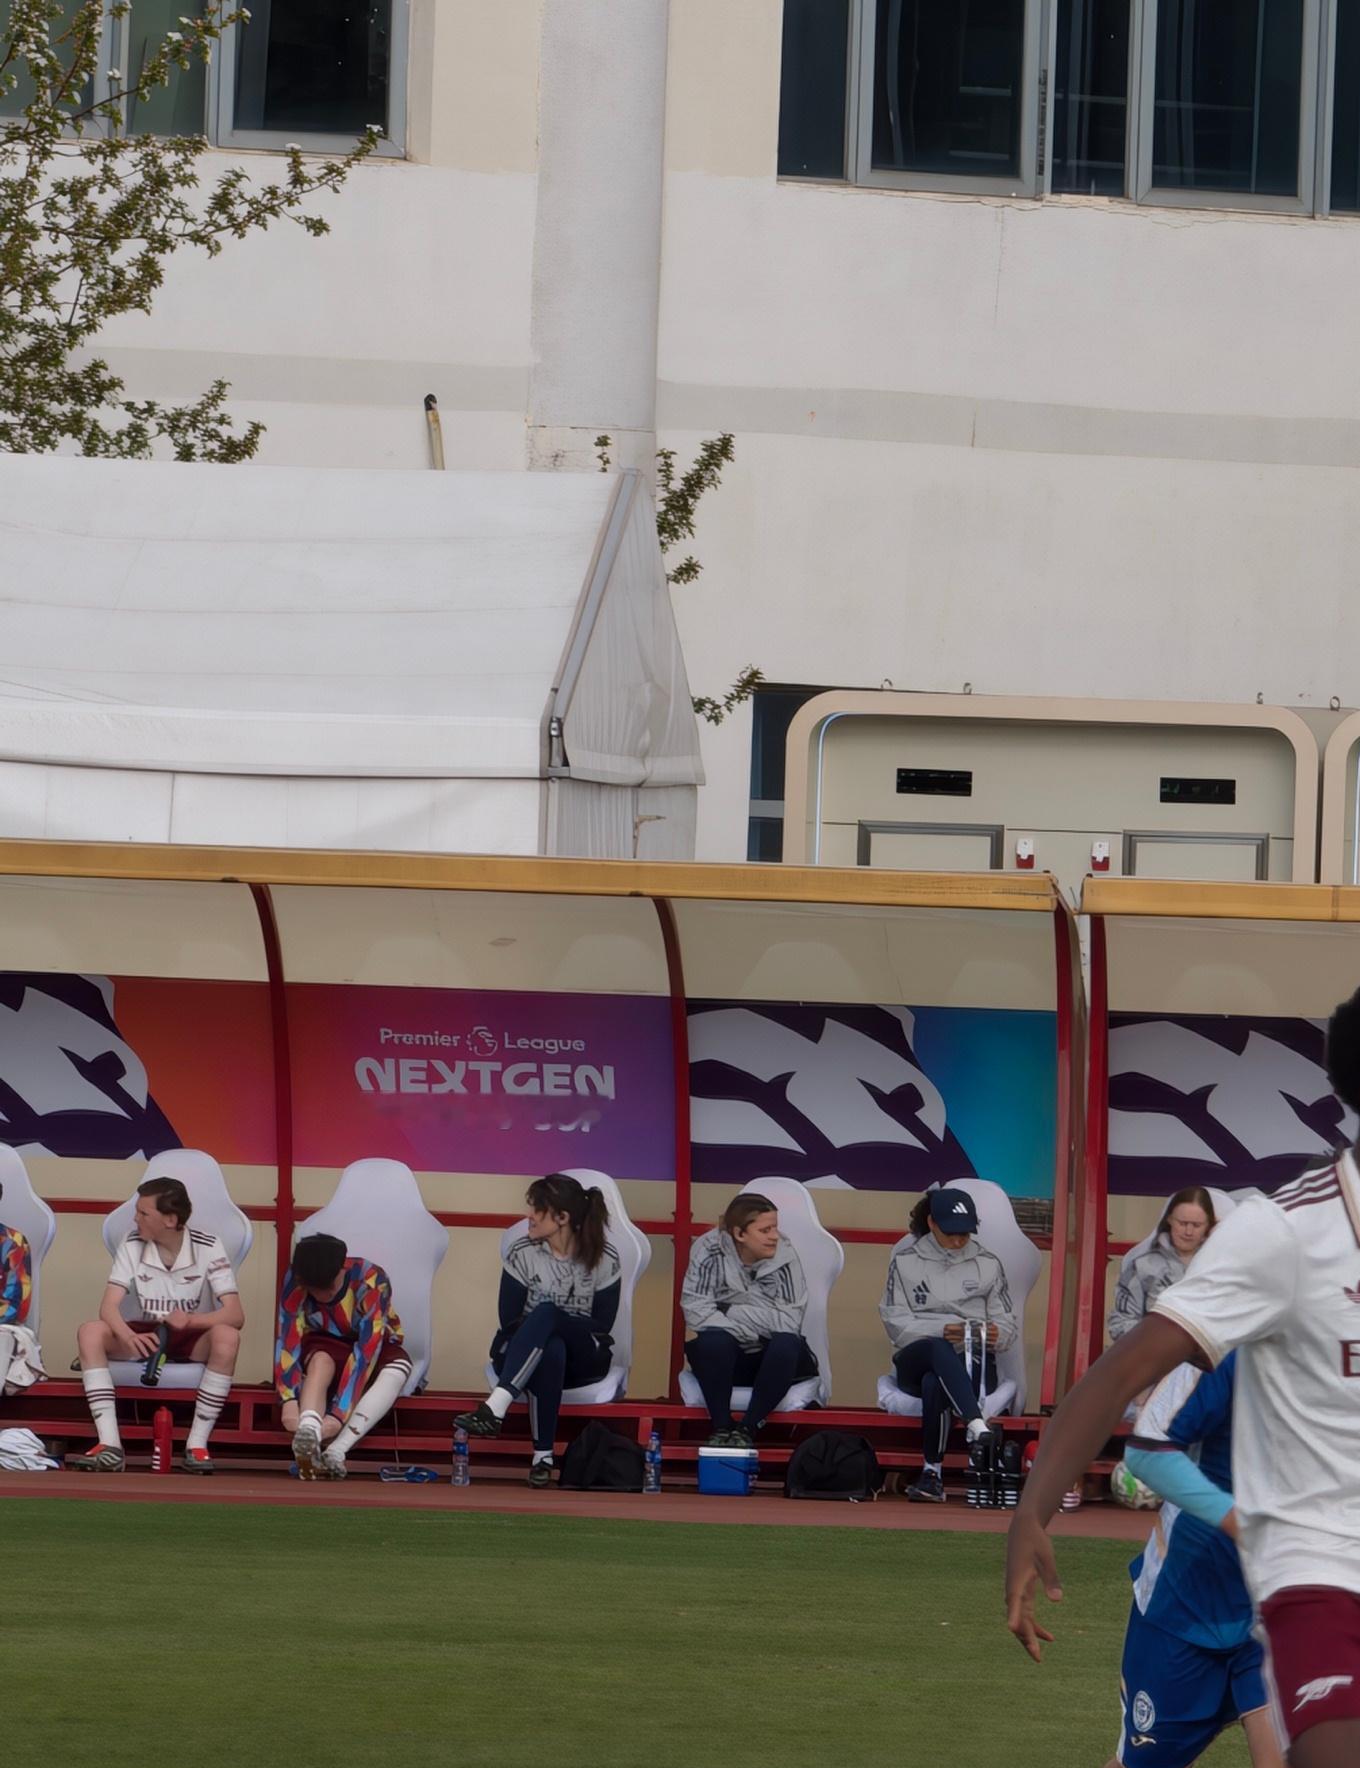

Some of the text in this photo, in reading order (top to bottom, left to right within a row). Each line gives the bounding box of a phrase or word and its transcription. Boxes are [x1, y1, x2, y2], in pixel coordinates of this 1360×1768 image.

[380, 1028, 586, 1054] Premier League
[355, 1057, 616, 1099] NEXTGEN
